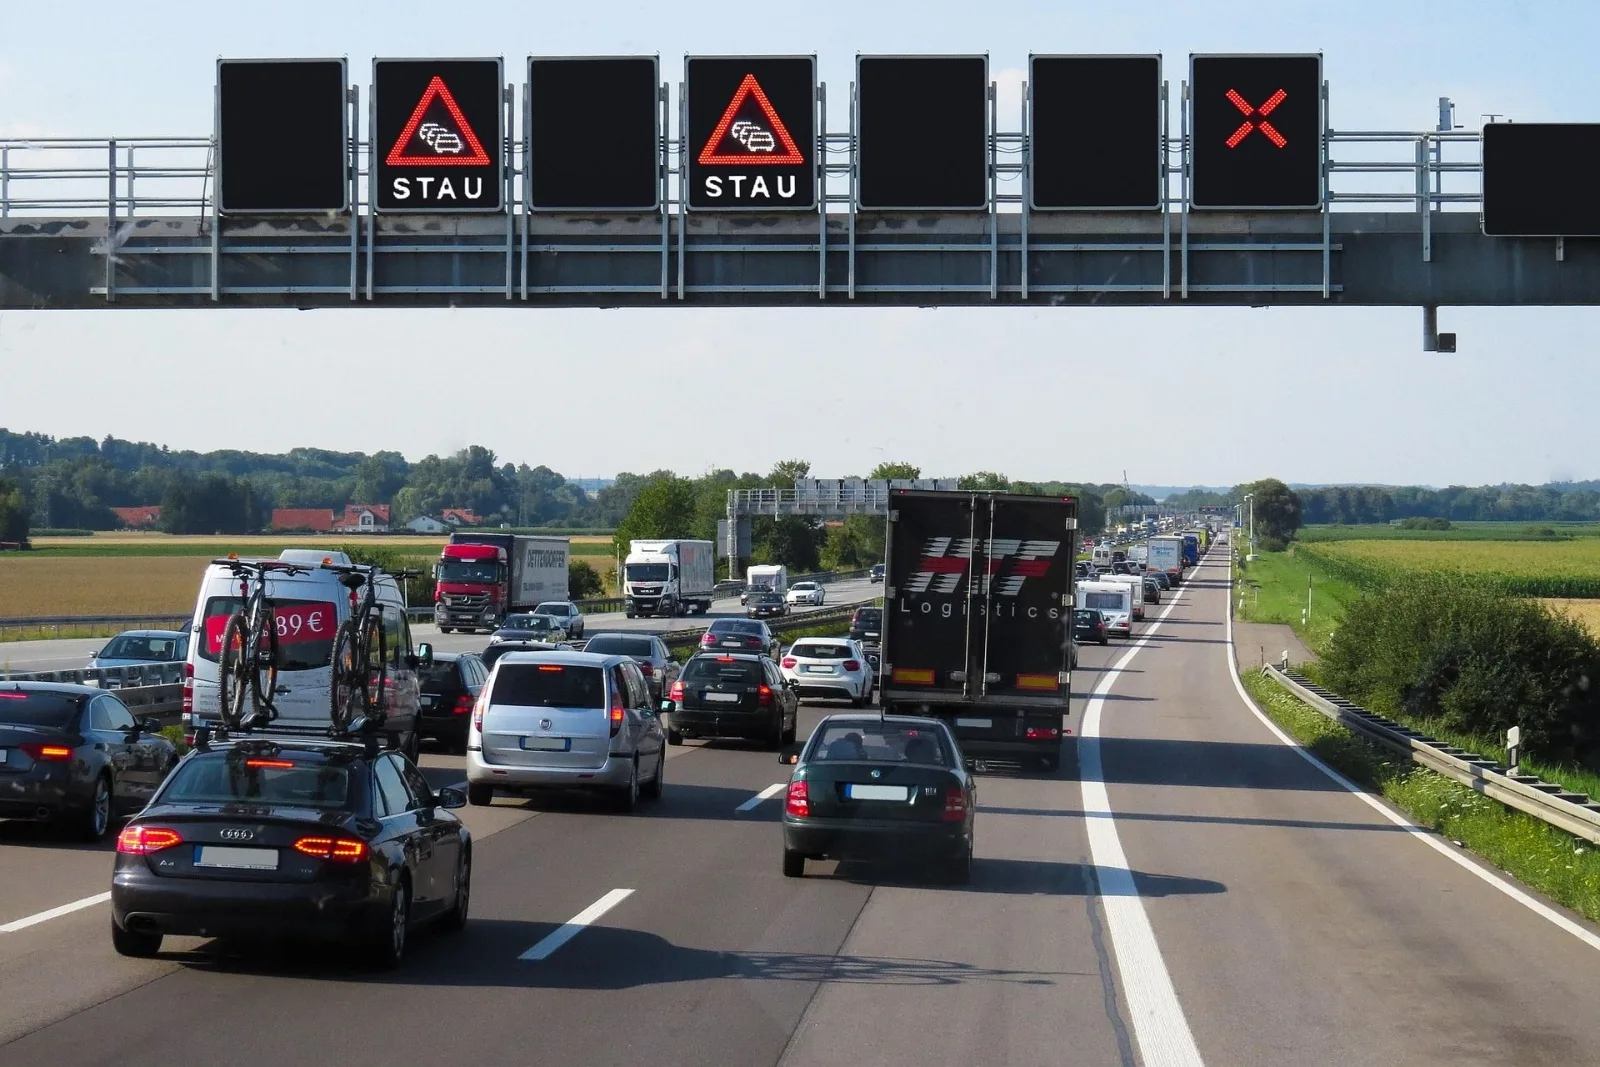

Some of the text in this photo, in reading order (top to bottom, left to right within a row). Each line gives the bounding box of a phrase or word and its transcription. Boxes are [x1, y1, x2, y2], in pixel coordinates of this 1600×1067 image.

[393, 177, 484, 200] STAU
[705, 175, 797, 198] STAU
[901, 597, 1059, 618] Logistics
[307, 611, 323, 632] €
